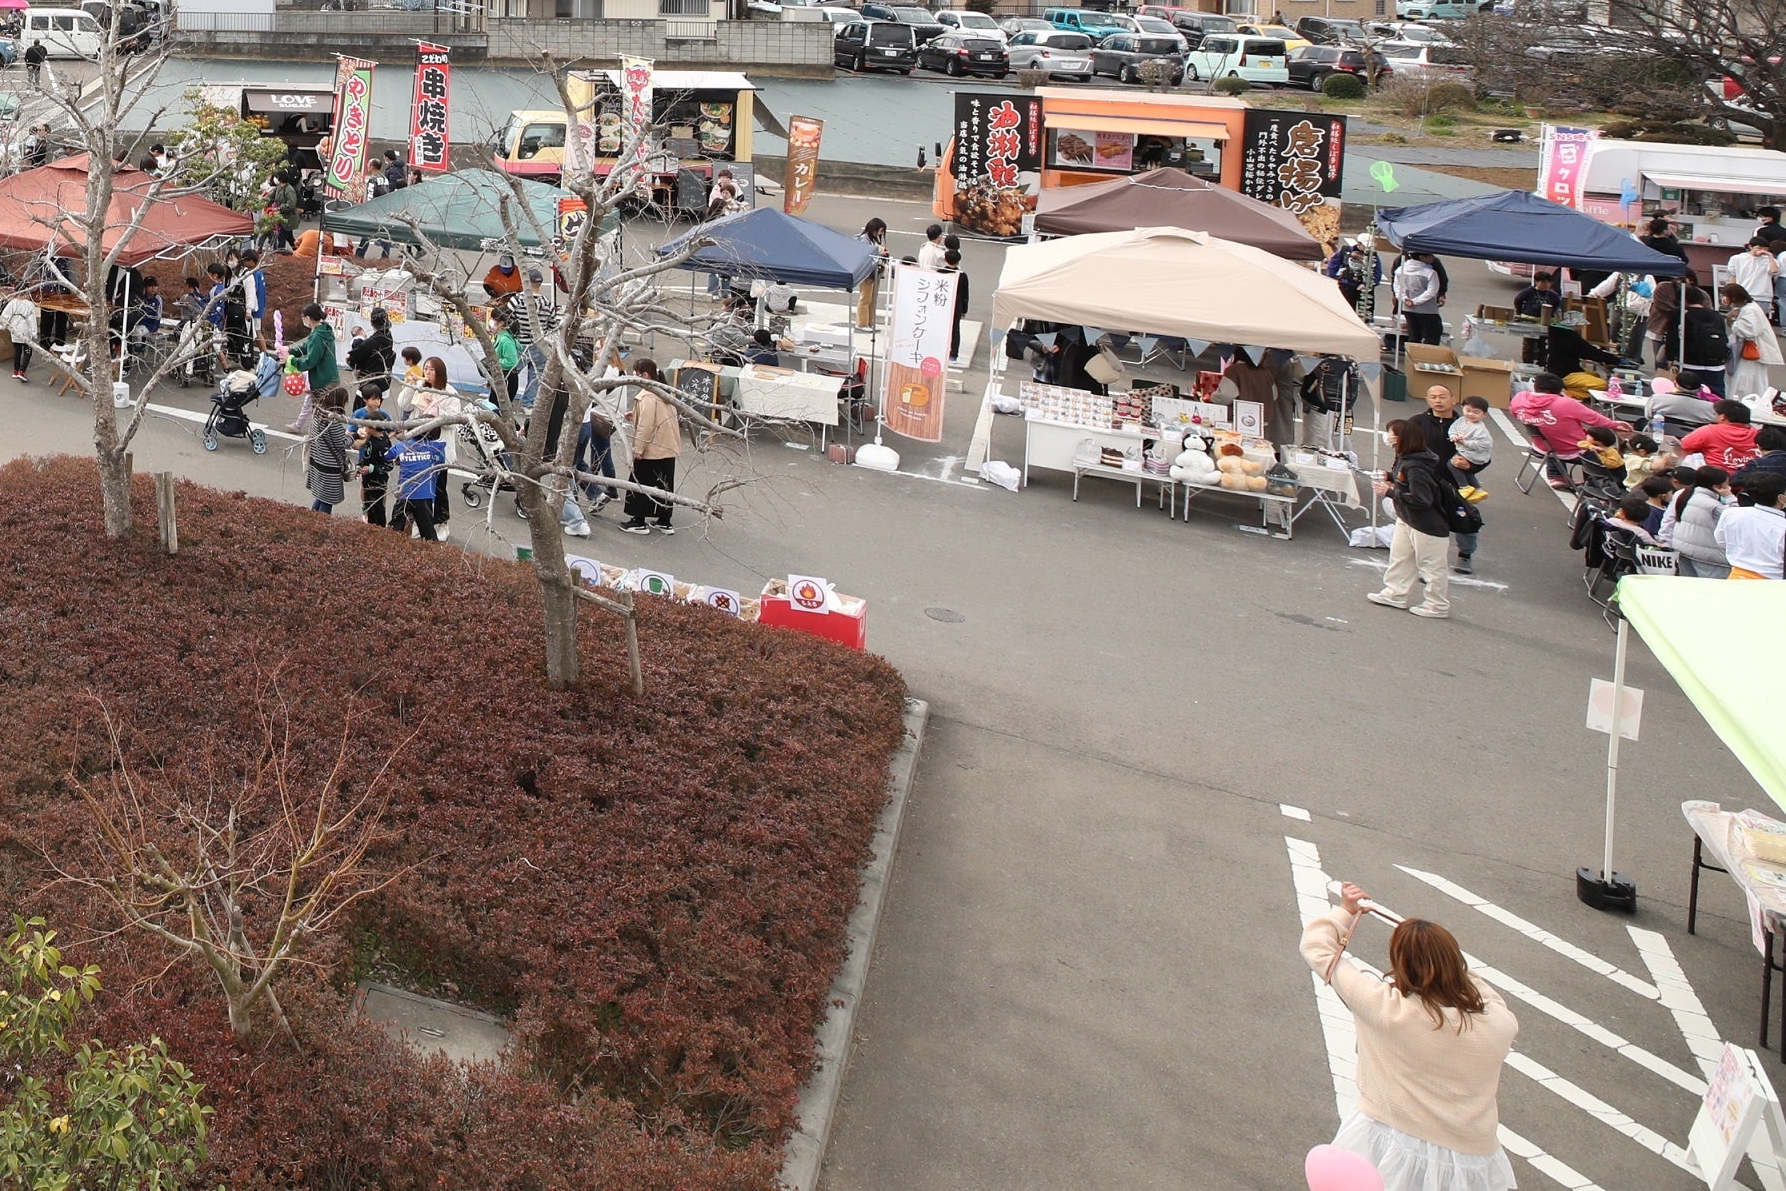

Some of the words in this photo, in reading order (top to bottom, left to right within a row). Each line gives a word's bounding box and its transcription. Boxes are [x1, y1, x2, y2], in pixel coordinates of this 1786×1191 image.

[270, 94, 317, 104] LOVE
[421, 54, 448, 65] こだわり
[333, 76, 367, 183] やきとり
[418, 67, 448, 164] 串焼き
[970, 98, 981, 186] 味と香りで食欲そそる
[794, 162, 809, 203] カレー
[1266, 118, 1280, 200] 一度食べたらやみつきの
[1277, 120, 1326, 214] 唐揚げ
[909, 278, 931, 364] シフォンケーキ
[933, 279, 949, 307] 米粉
[1641, 553, 1673, 569] NIKE
